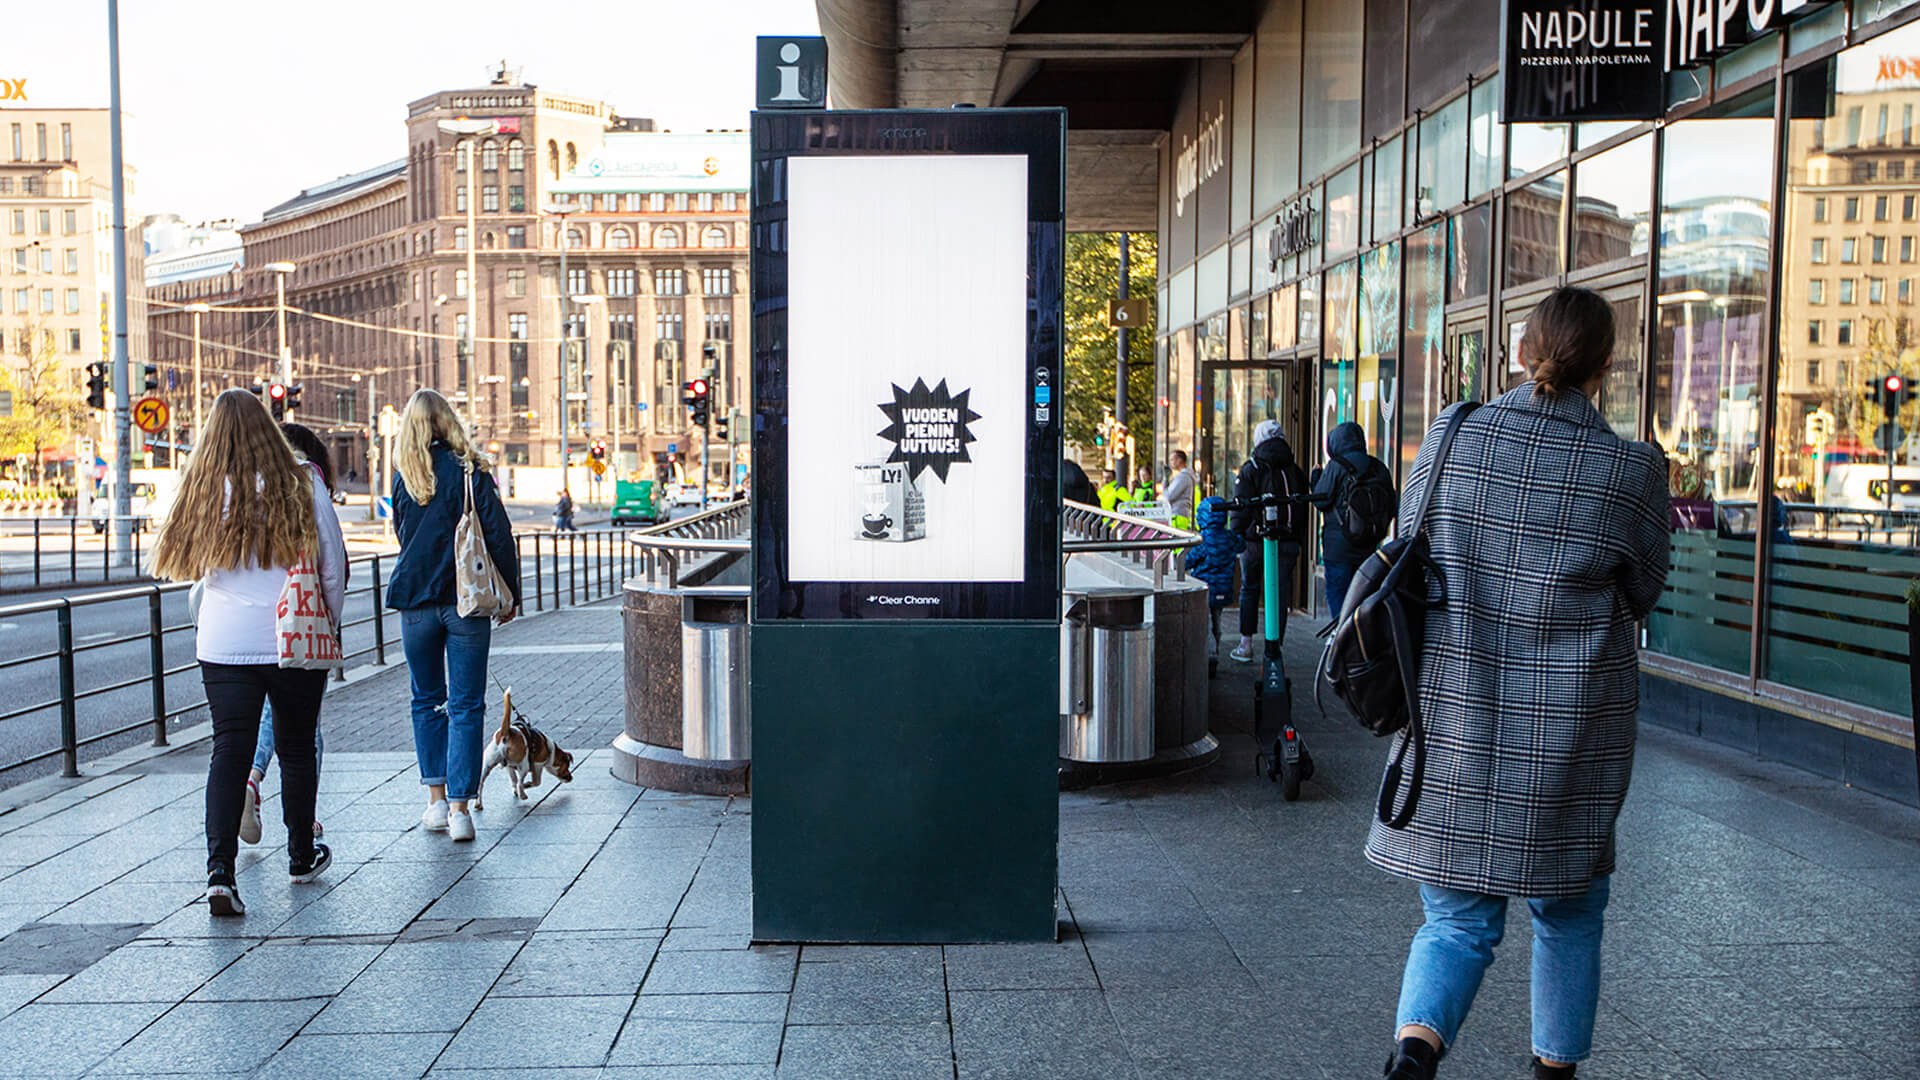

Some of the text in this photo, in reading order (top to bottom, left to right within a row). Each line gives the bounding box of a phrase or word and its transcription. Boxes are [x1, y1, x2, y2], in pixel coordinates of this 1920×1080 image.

[1521, 9, 1653, 49] NAPULE
[1520, 54, 1651, 66] PIZZERIA NAPOLETANA
[1116, 305, 1128, 321] 6
[902, 408, 958, 423] VUODEN
[906, 423, 954, 438] PIENIN
[900, 438, 960, 454] UUTUUS!
[879, 595, 903, 605] Clear
